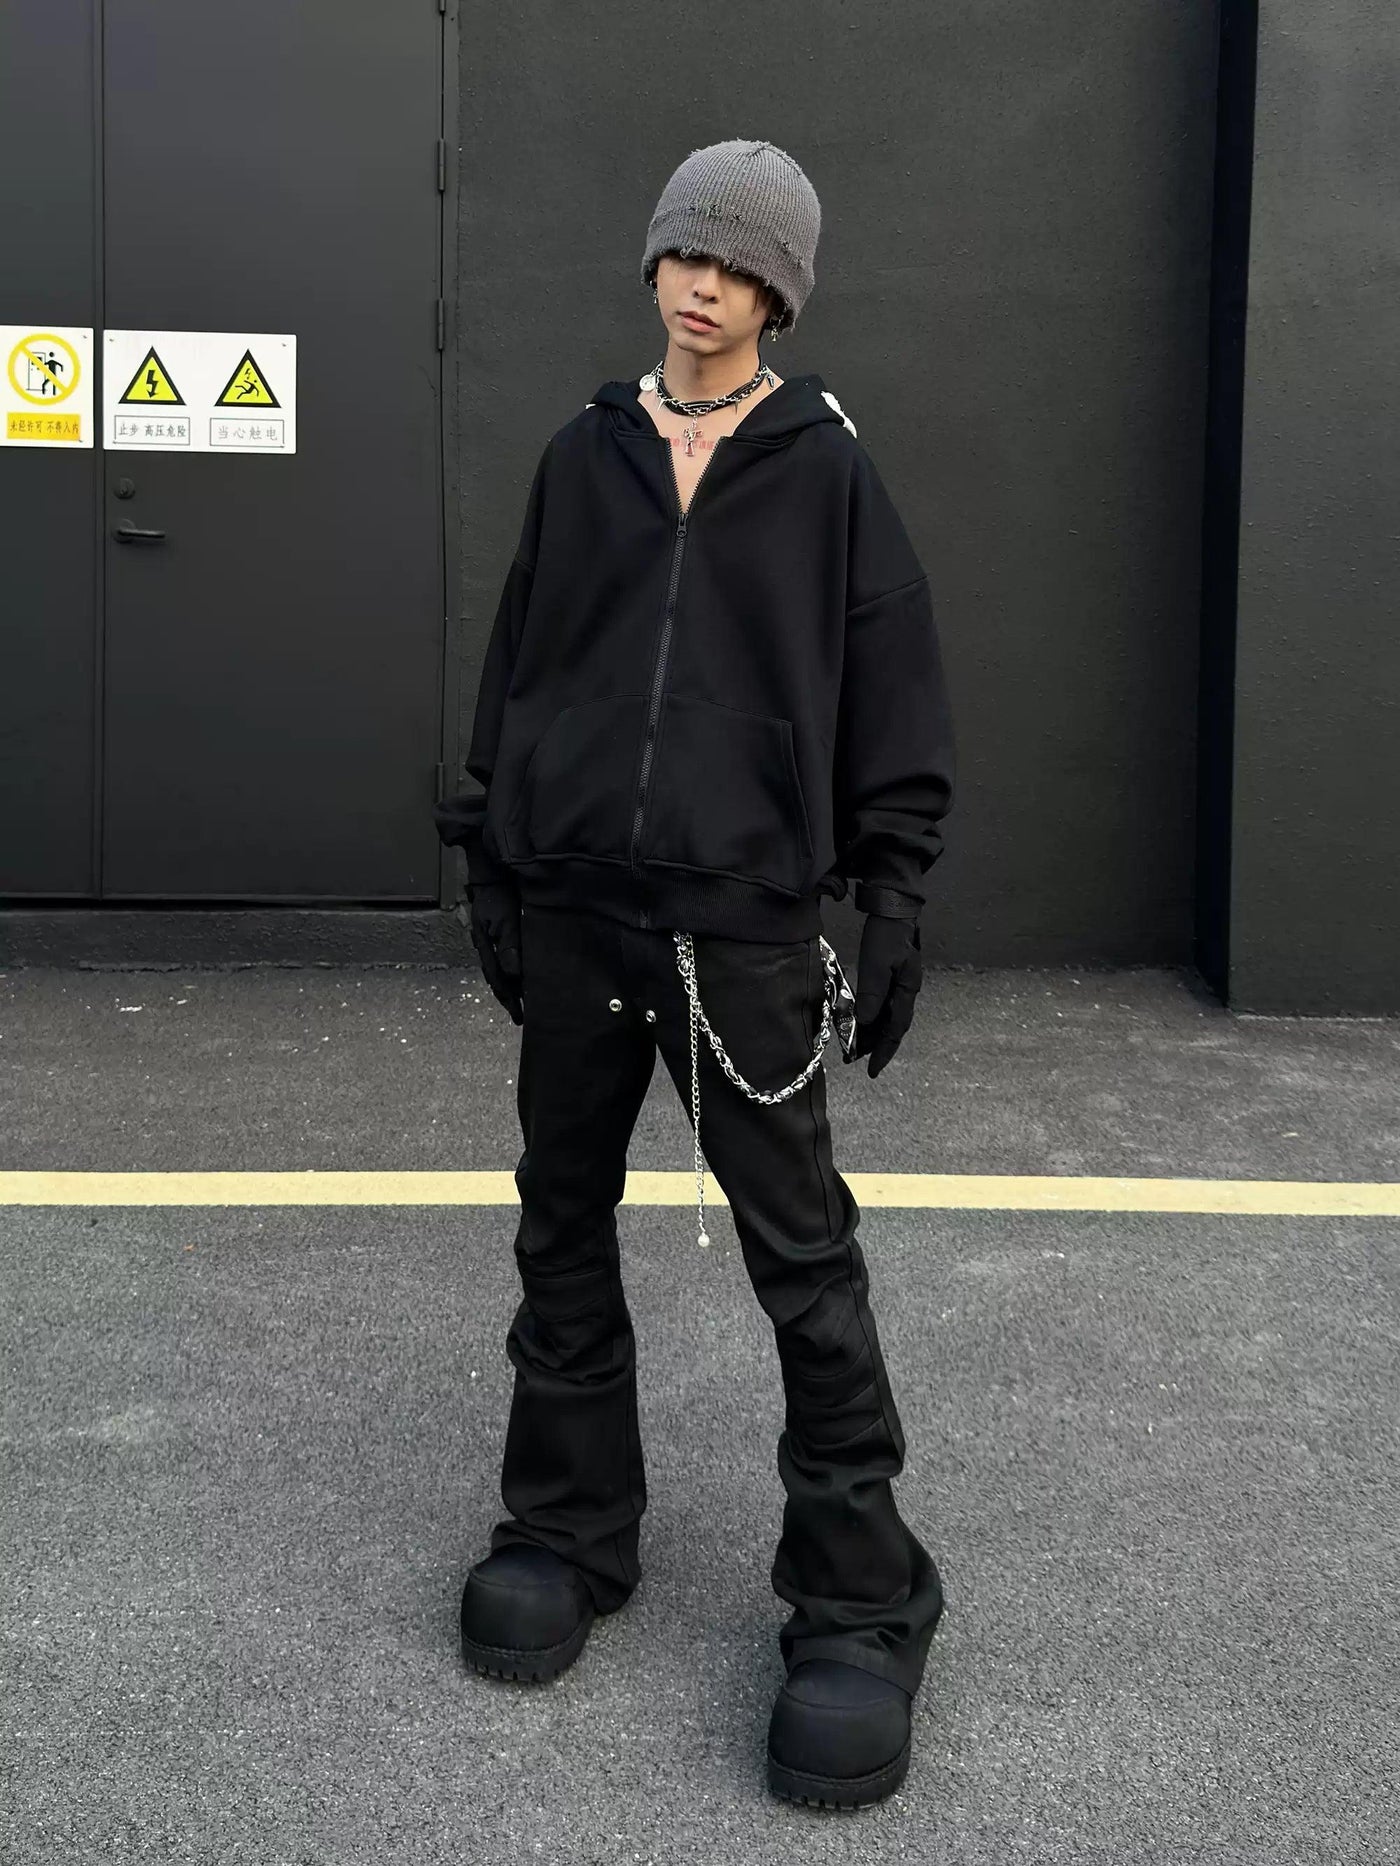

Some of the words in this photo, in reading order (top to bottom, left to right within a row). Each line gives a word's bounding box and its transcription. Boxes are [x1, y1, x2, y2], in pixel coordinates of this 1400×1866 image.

[118, 423, 138, 436] 止步
[144, 424, 186, 437] 高压危险
[218, 425, 278, 441] 当心触电
